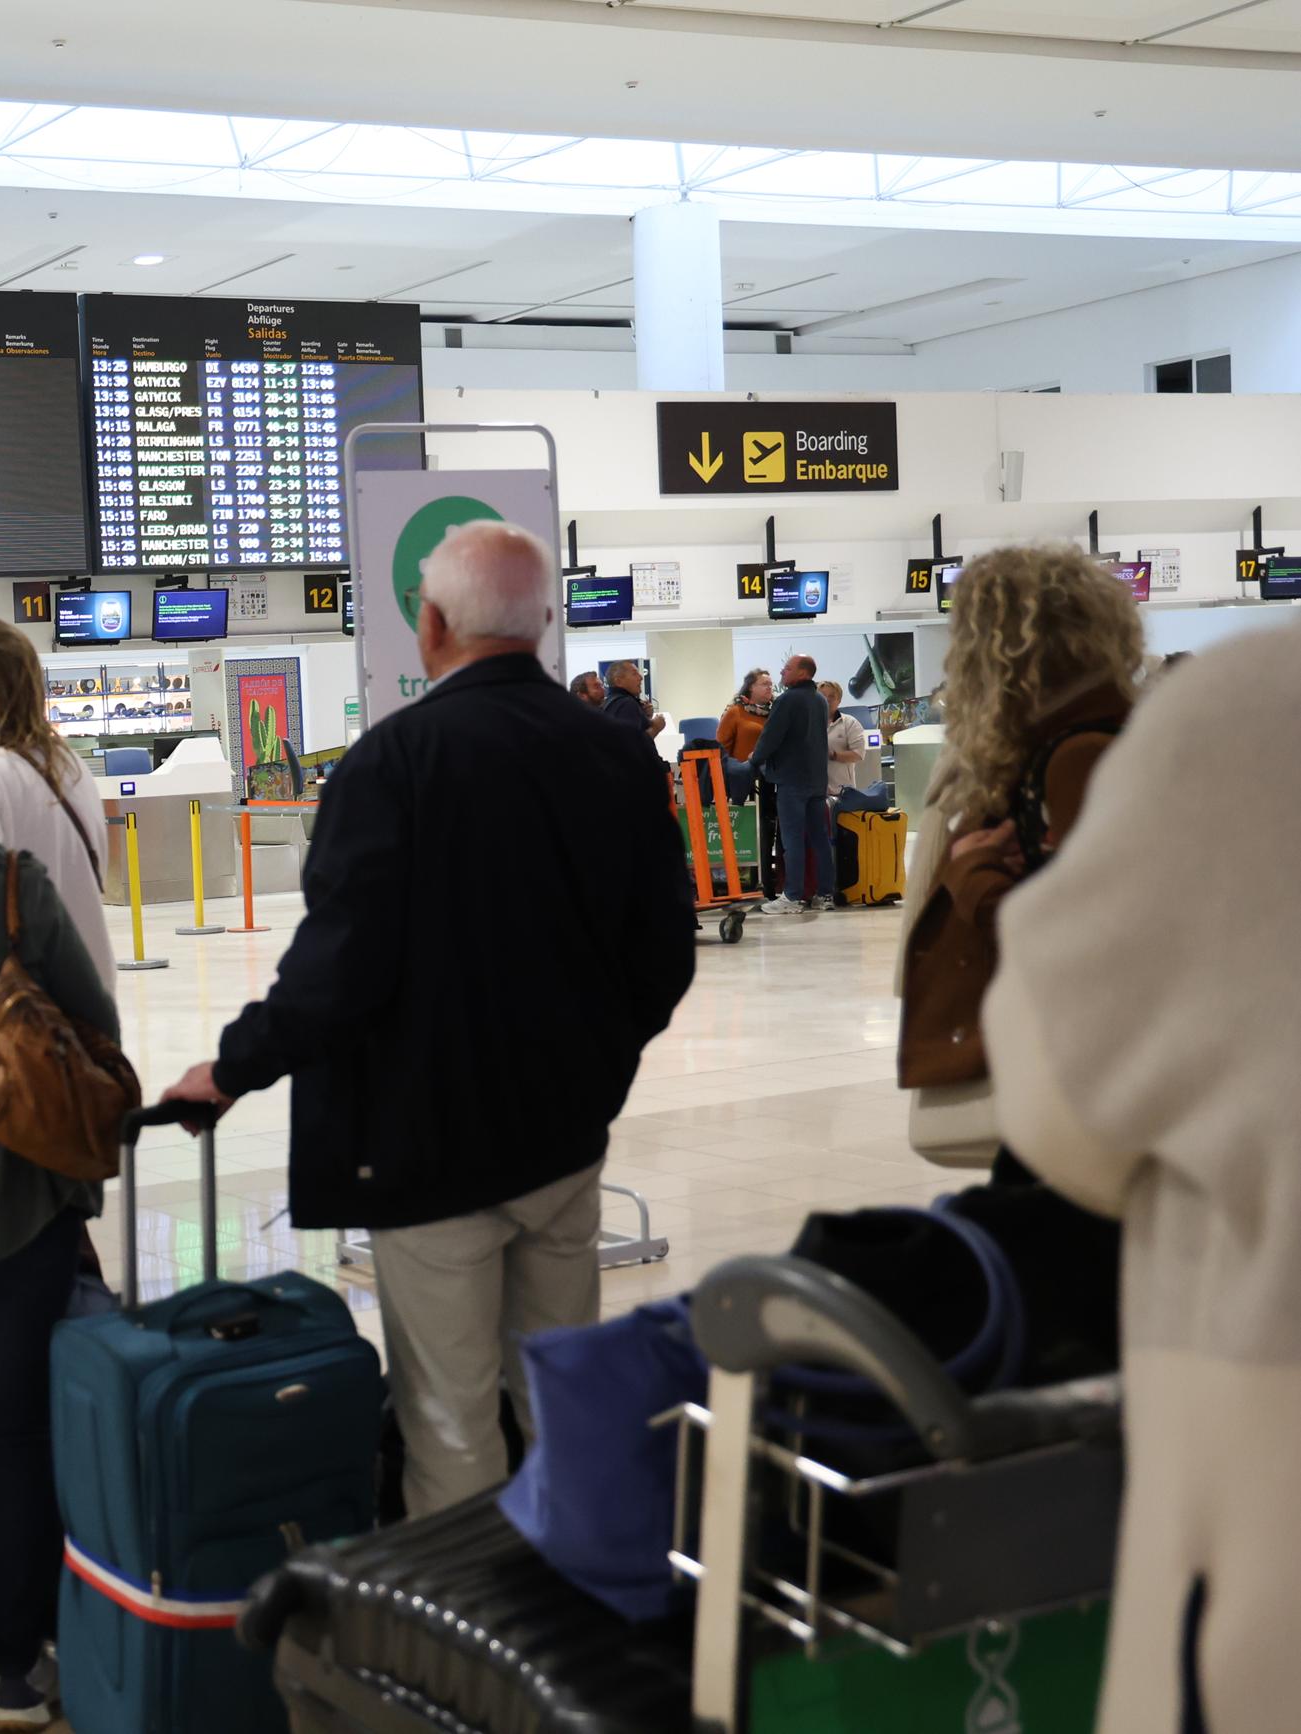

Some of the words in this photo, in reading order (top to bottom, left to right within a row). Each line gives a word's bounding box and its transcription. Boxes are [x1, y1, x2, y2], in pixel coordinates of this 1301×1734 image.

[247, 303, 295, 314] Departures
[247, 316, 282, 326] Abflüge
[248, 328, 288, 339] Salidas
[134, 377, 180, 387] GATWICK
[135, 392, 181, 402] GATWICK
[136, 407, 202, 416] GLASG/PRES
[136, 422, 176, 431] MALAGA
[796, 430, 868, 454] Boarding
[138, 451, 204, 461] MANCHESTER
[138, 466, 205, 476] MANCHESTER
[796, 460, 888, 483] Embarque
[139, 481, 185, 491] GLASGOW
[140, 511, 167, 520] FARO
[141, 525, 207, 535] LEEDS/BRAD
[142, 539, 208, 550] MANCHESTER
[142, 554, 209, 565] LONDON/STN
[1239, 561, 1256, 577] 17
[741, 576, 761, 594] 14
[910, 570, 928, 589] 15
[310, 588, 332, 608] 12
[22, 596, 43, 617] 11
